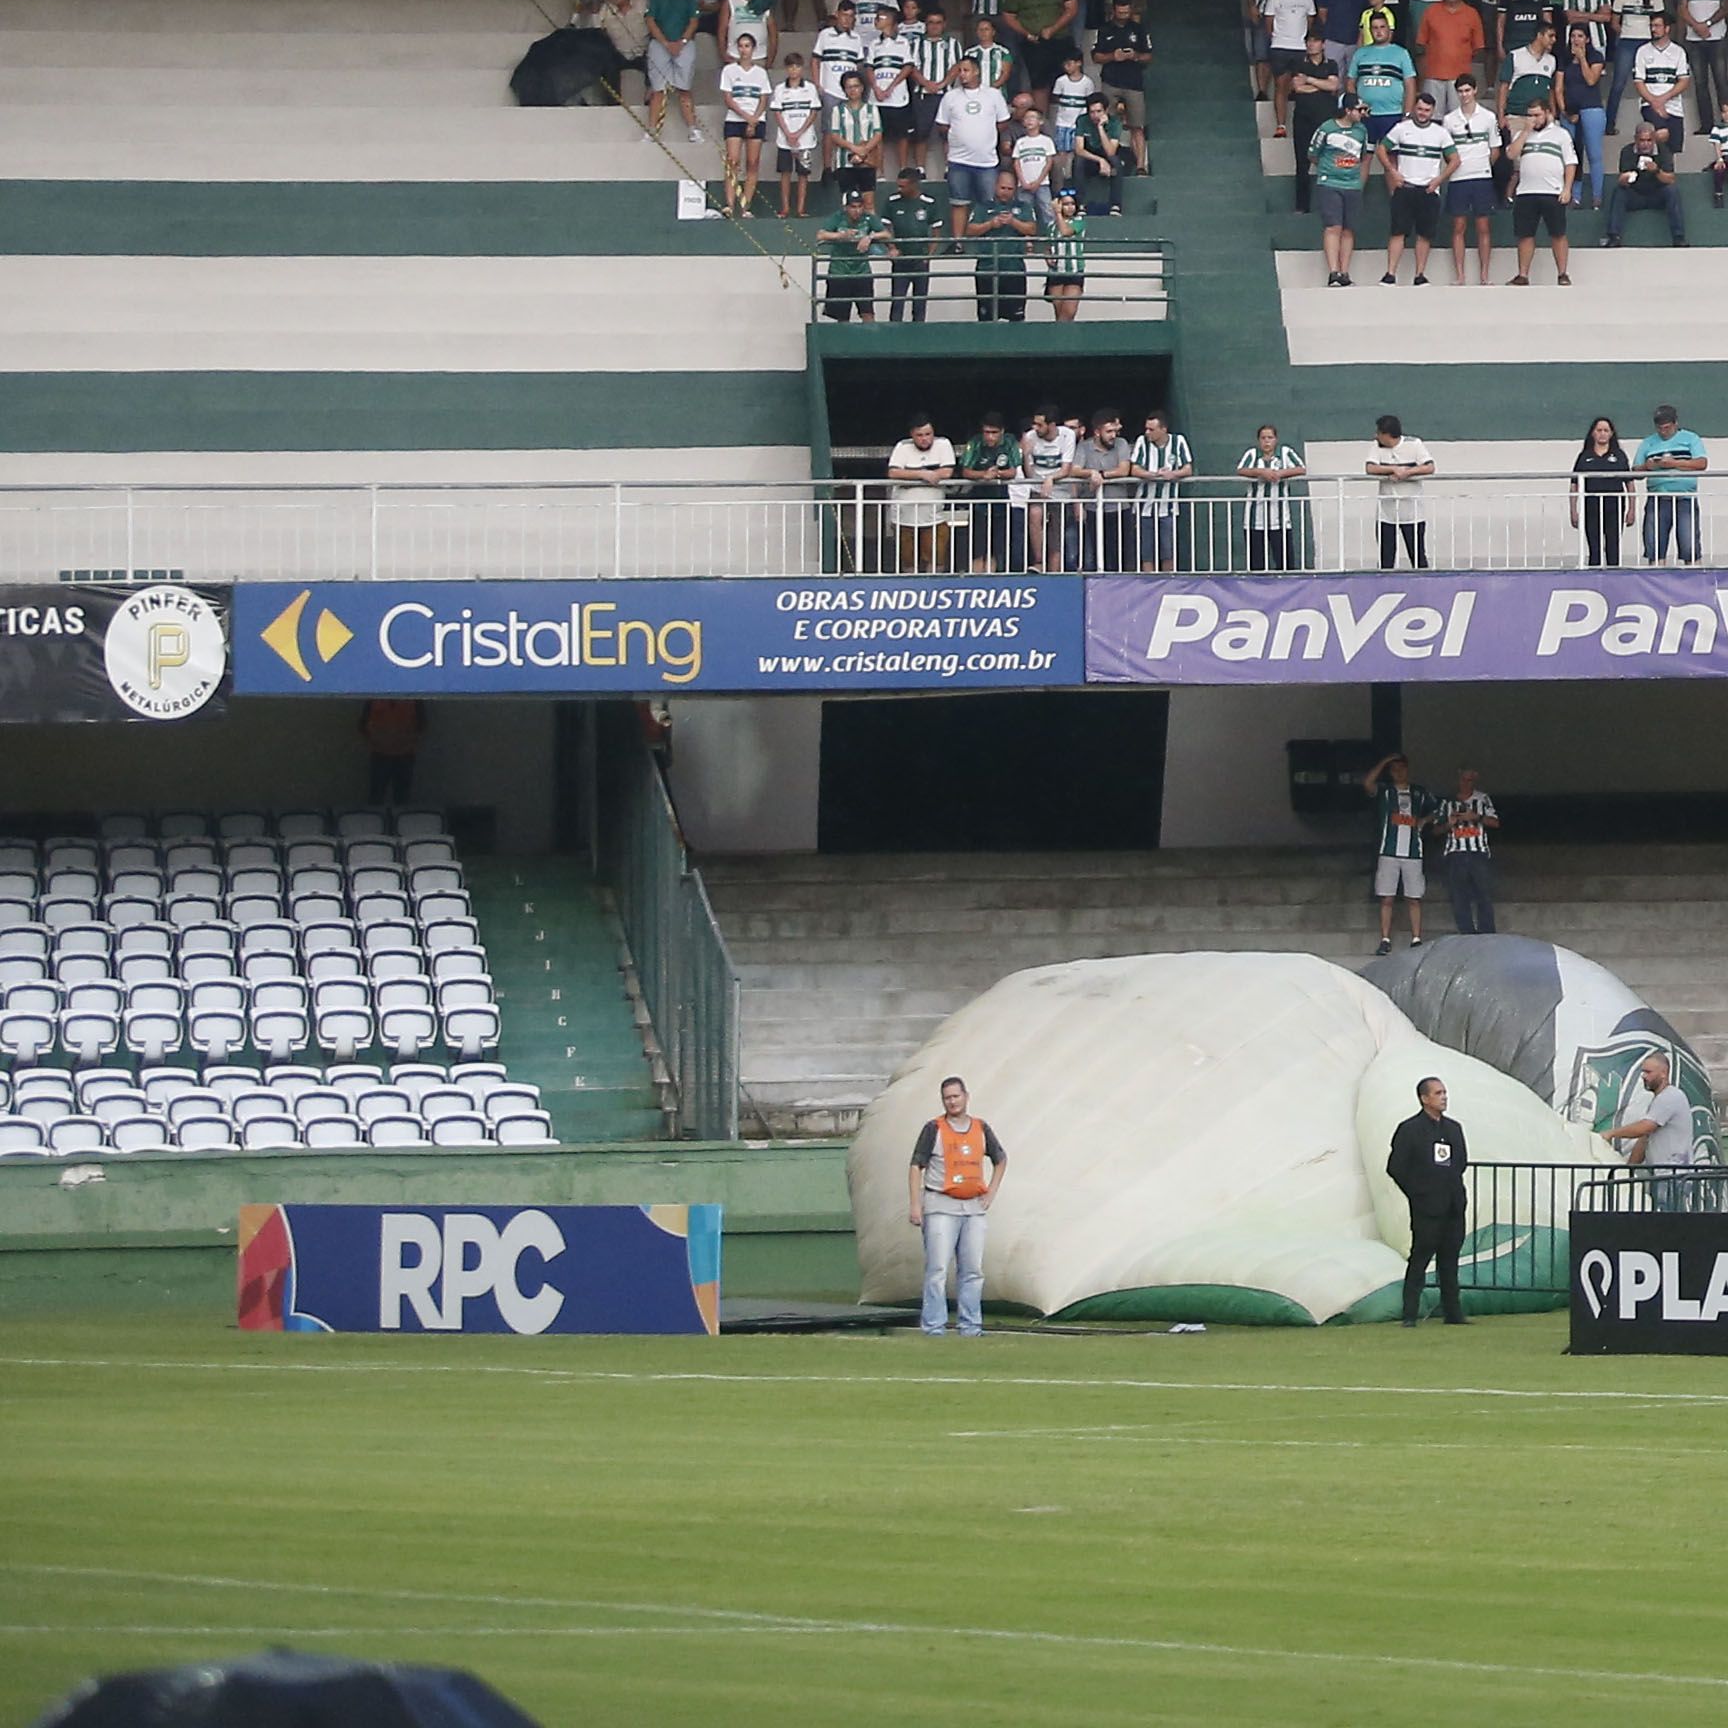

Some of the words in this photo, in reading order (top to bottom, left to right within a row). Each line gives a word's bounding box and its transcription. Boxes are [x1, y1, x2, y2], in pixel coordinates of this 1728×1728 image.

[1514, 14, 1538, 22] CAIXA
[129, 593, 202, 621] PINFER
[776, 590, 865, 611] OBRAS
[870, 587, 1036, 610] INDUSTRIAIS
[794, 620, 809, 640] E
[812, 617, 1019, 640] CORPORATIVAS
[1146, 591, 1478, 665] PanVel
[379, 603, 702, 683] CristalEng
[757, 649, 1055, 676] www.cristaleng.com.br
[121, 680, 211, 712] METALÚRGICA
[380, 1209, 567, 1334] RPC
